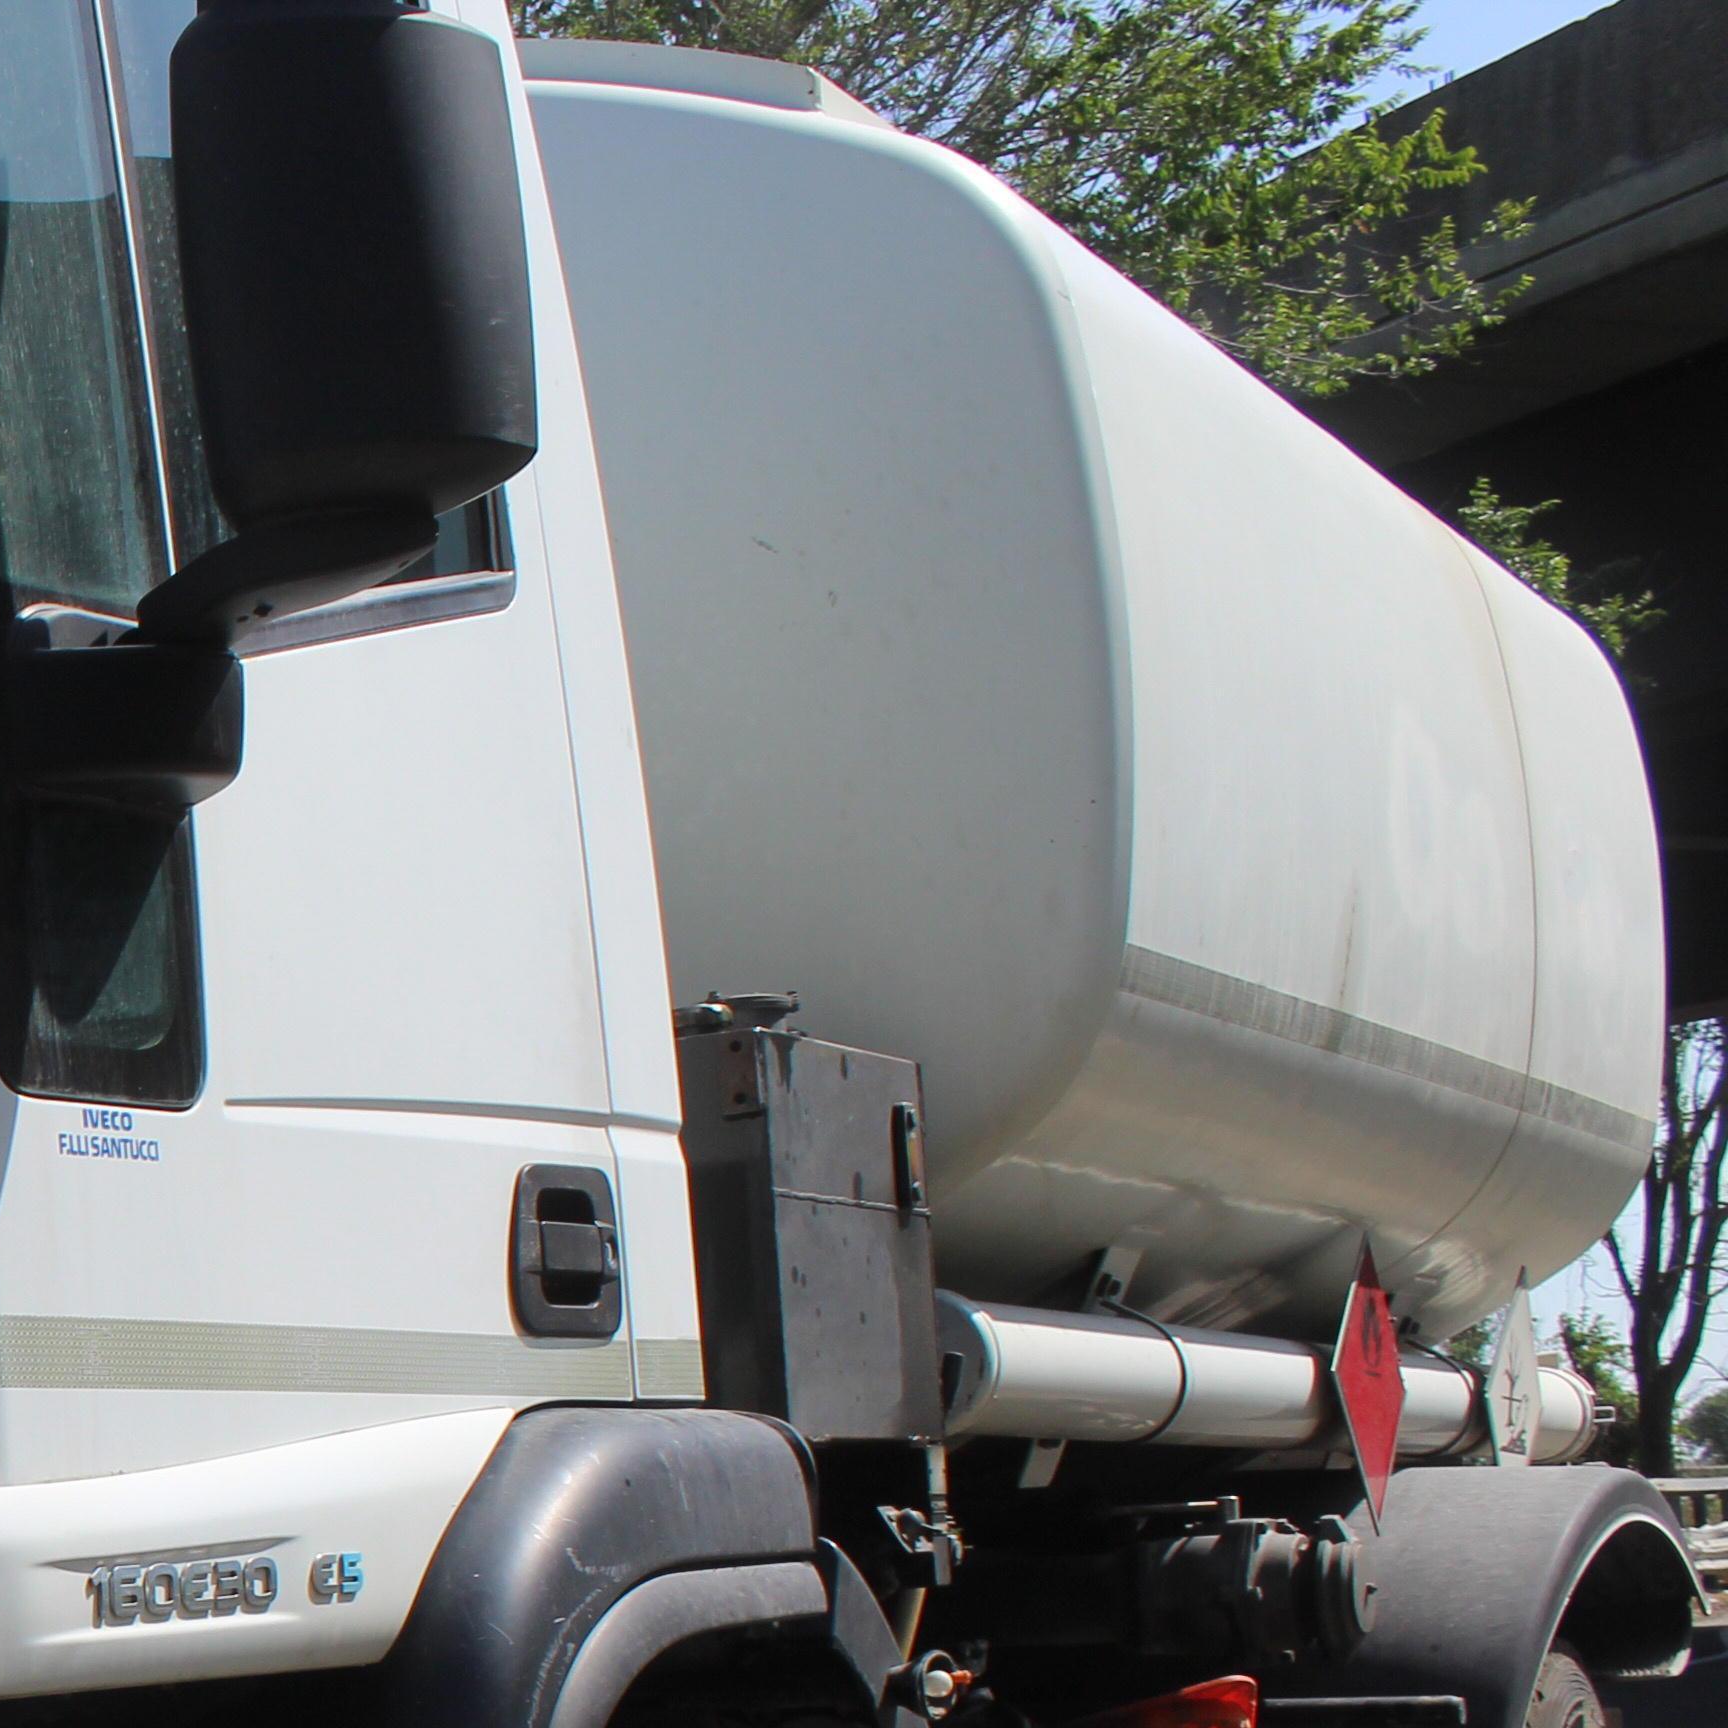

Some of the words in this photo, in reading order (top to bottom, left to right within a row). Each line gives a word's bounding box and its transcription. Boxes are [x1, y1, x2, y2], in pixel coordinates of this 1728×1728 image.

[82, 1108, 133, 1131] IVECO
[90, 1135, 160, 1162] SANTUCCI
[308, 1551, 365, 1604] E5
